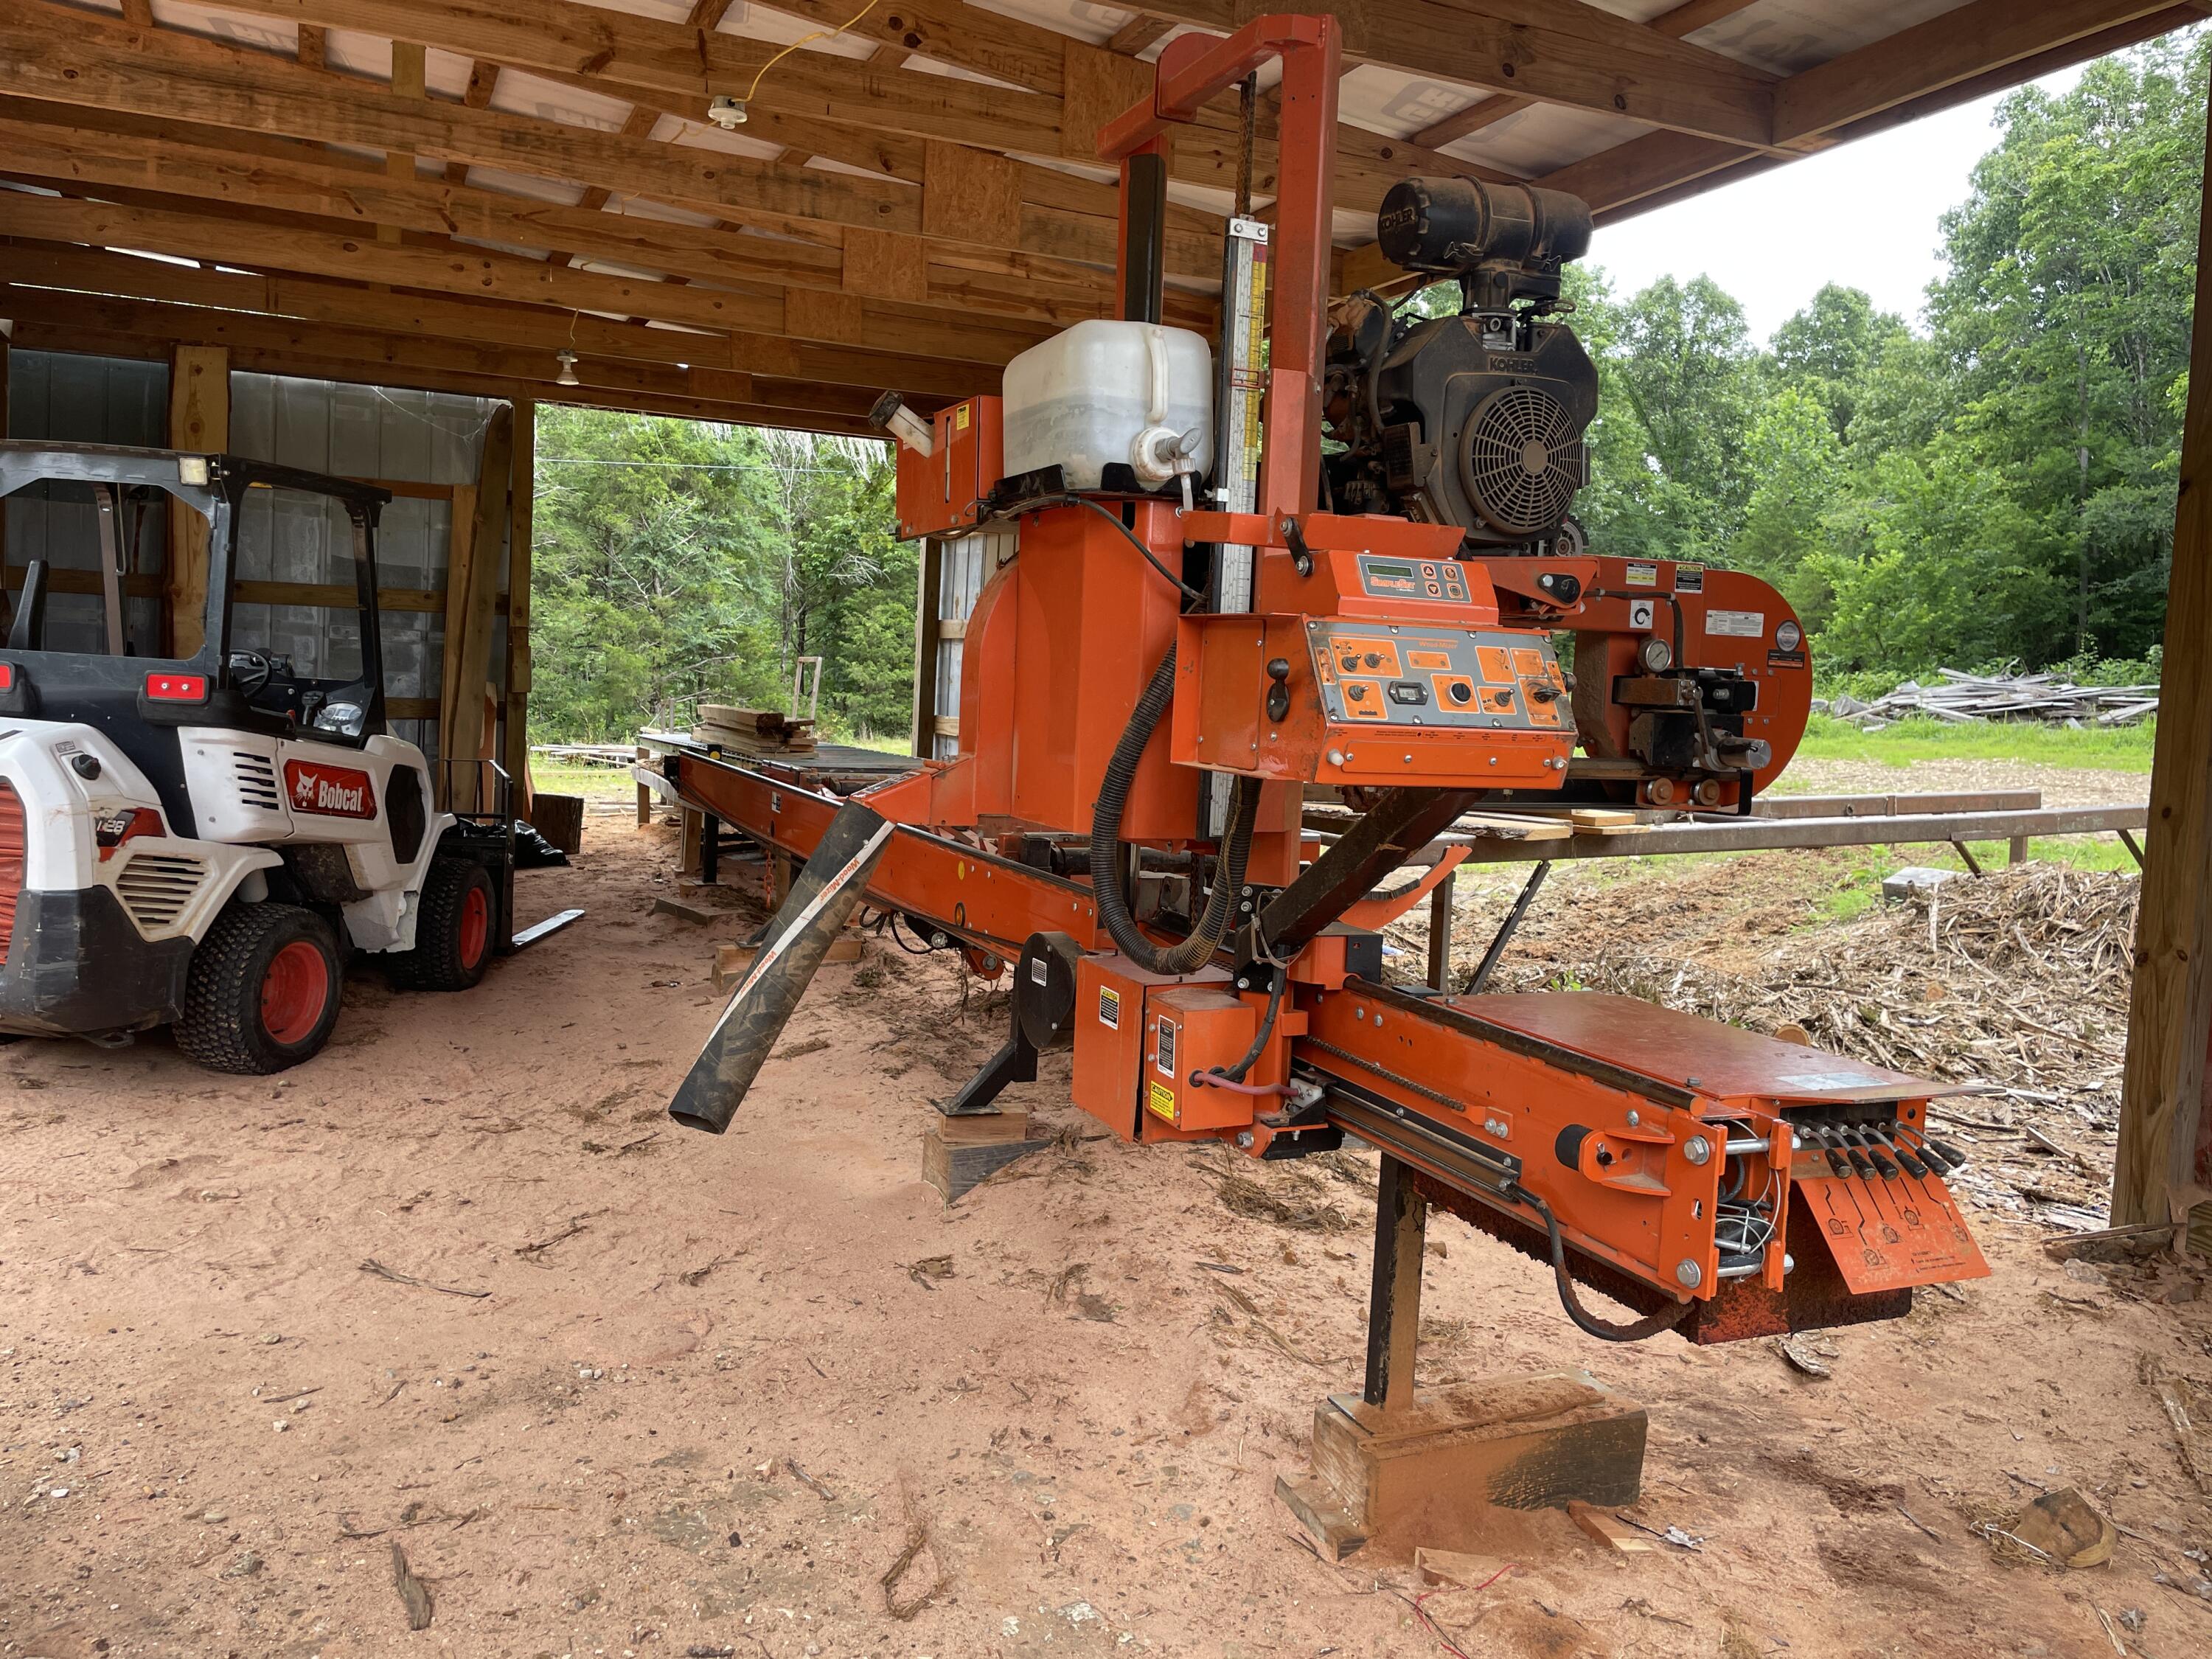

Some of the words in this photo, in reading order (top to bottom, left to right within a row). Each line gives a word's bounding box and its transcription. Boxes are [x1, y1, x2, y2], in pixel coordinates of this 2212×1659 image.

[318, 780, 363, 812] Bobcat
[820, 858, 860, 901] Wood-Mizer
[740, 950, 776, 996] Wood-Mizer
[1152, 1085, 1171, 1101] CAUTION
